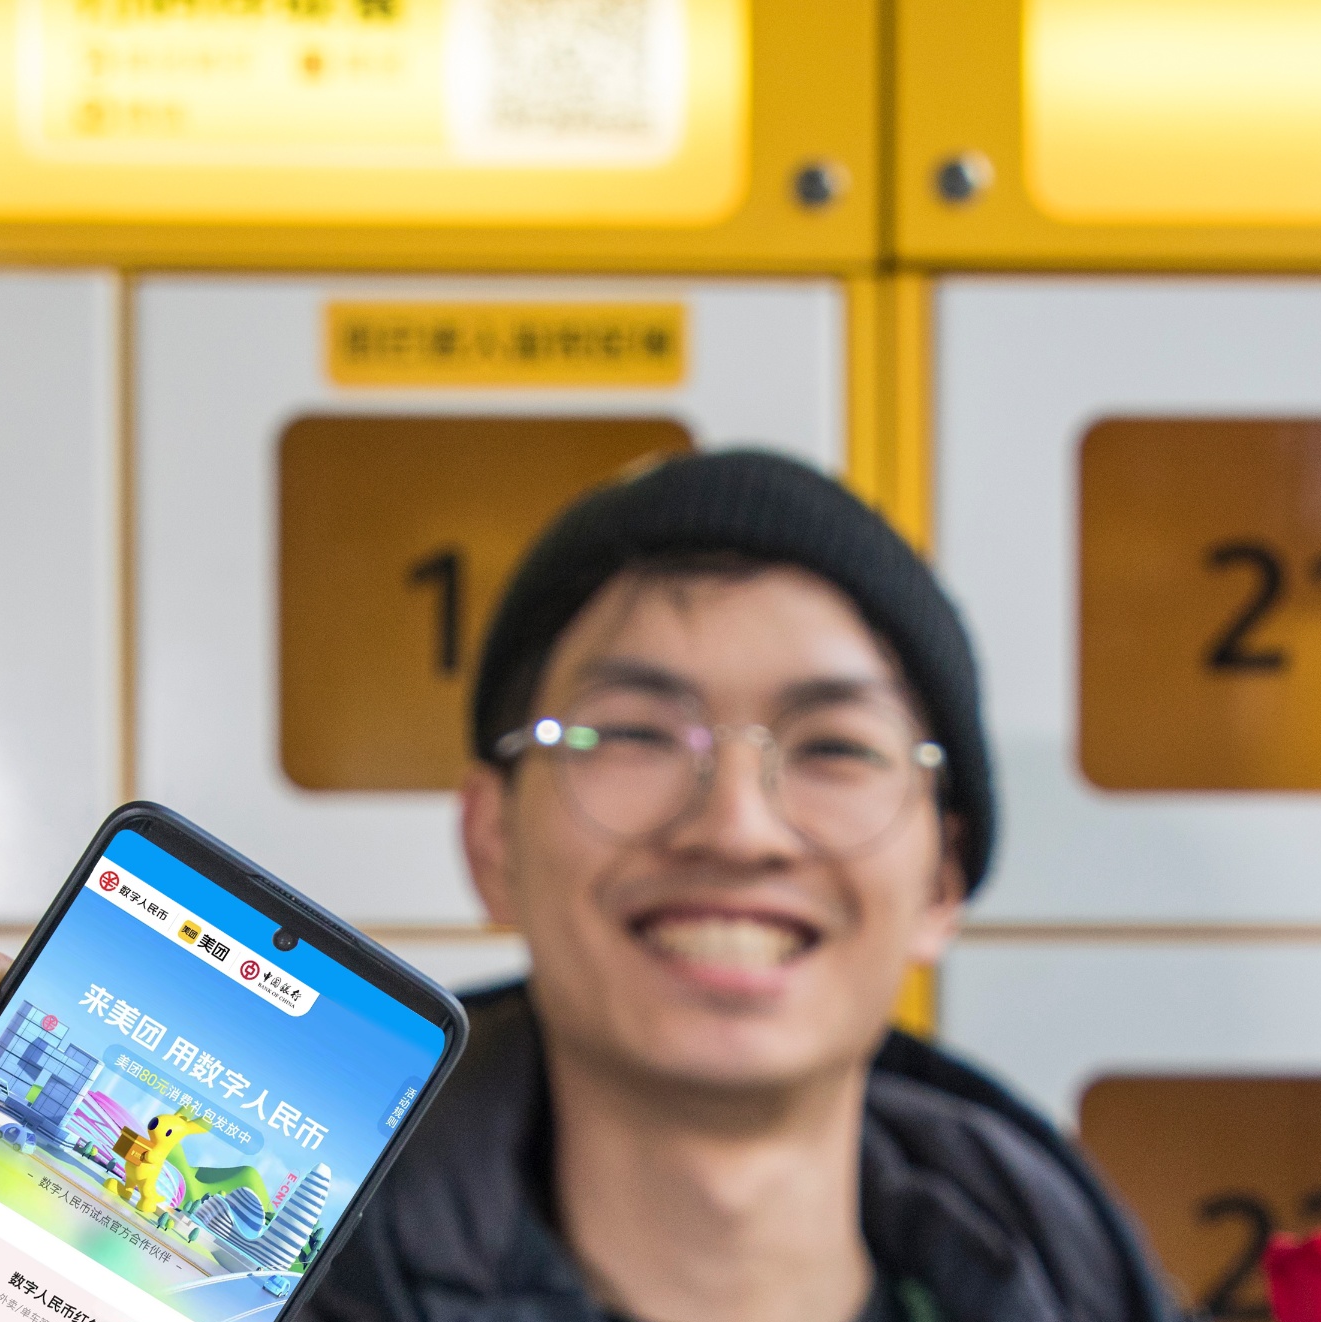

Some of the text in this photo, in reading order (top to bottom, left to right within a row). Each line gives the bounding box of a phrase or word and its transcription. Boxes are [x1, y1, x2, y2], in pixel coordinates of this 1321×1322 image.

[118, 884, 169, 921] 数字人民币
[181, 923, 199, 941] 美团
[197, 933, 230, 962] 美团
[256, 982, 296, 1008] BANK OF CHINA
[78, 983, 329, 1150] 来美团 用数字人民币
[114, 1053, 252, 1146] 美团80元消费礼包发放中
[385, 1086, 418, 1129] 活动规则
[271, 1172, 298, 1209] E-CNY
